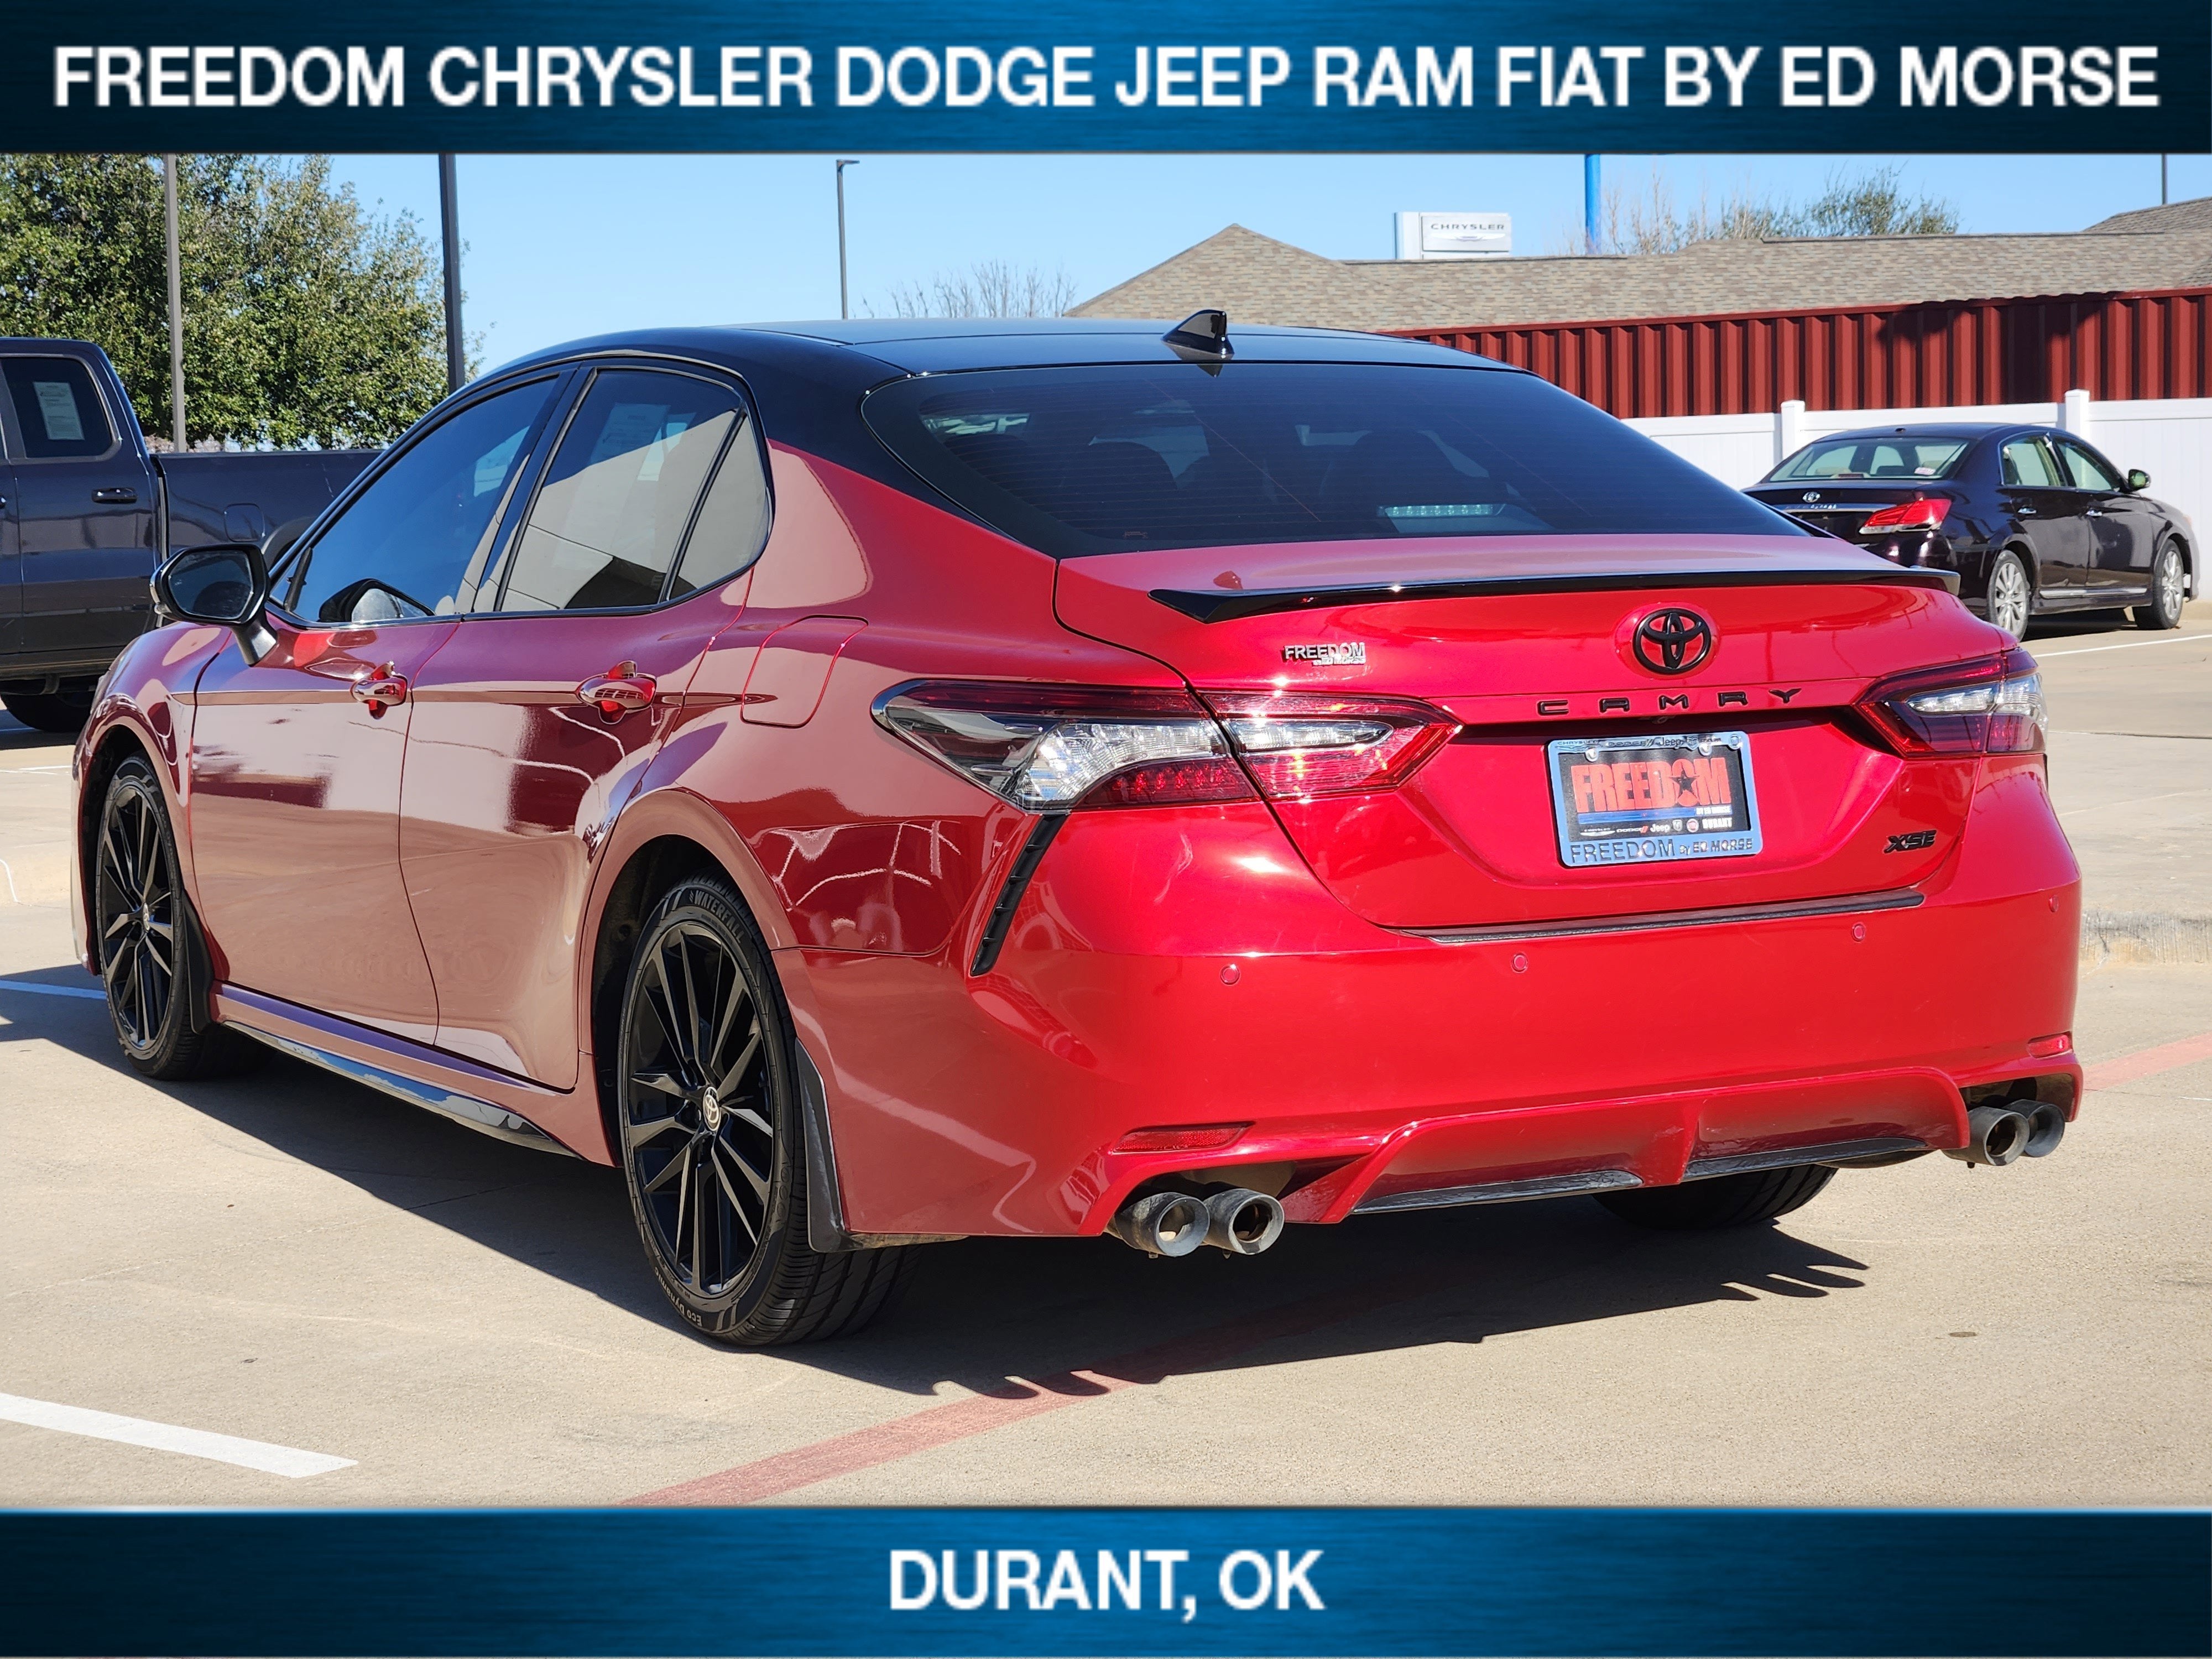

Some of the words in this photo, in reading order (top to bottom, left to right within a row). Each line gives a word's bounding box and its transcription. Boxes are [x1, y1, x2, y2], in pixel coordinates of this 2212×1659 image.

[1284, 641, 1365, 659] FREEDOM
[1537, 687, 1801, 716] CAMRY
[1658, 737, 1682, 748] Jeep
[1571, 757, 1731, 813] FREEDOM
[1650, 823, 1671, 833] Jeep
[1571, 838, 1676, 863] FREEDOM
[1693, 841, 1709, 853] ED
[1710, 838, 1753, 852] MORSE
[1883, 829, 1937, 854] XSE
[694, 890, 744, 943] WATERFALL
